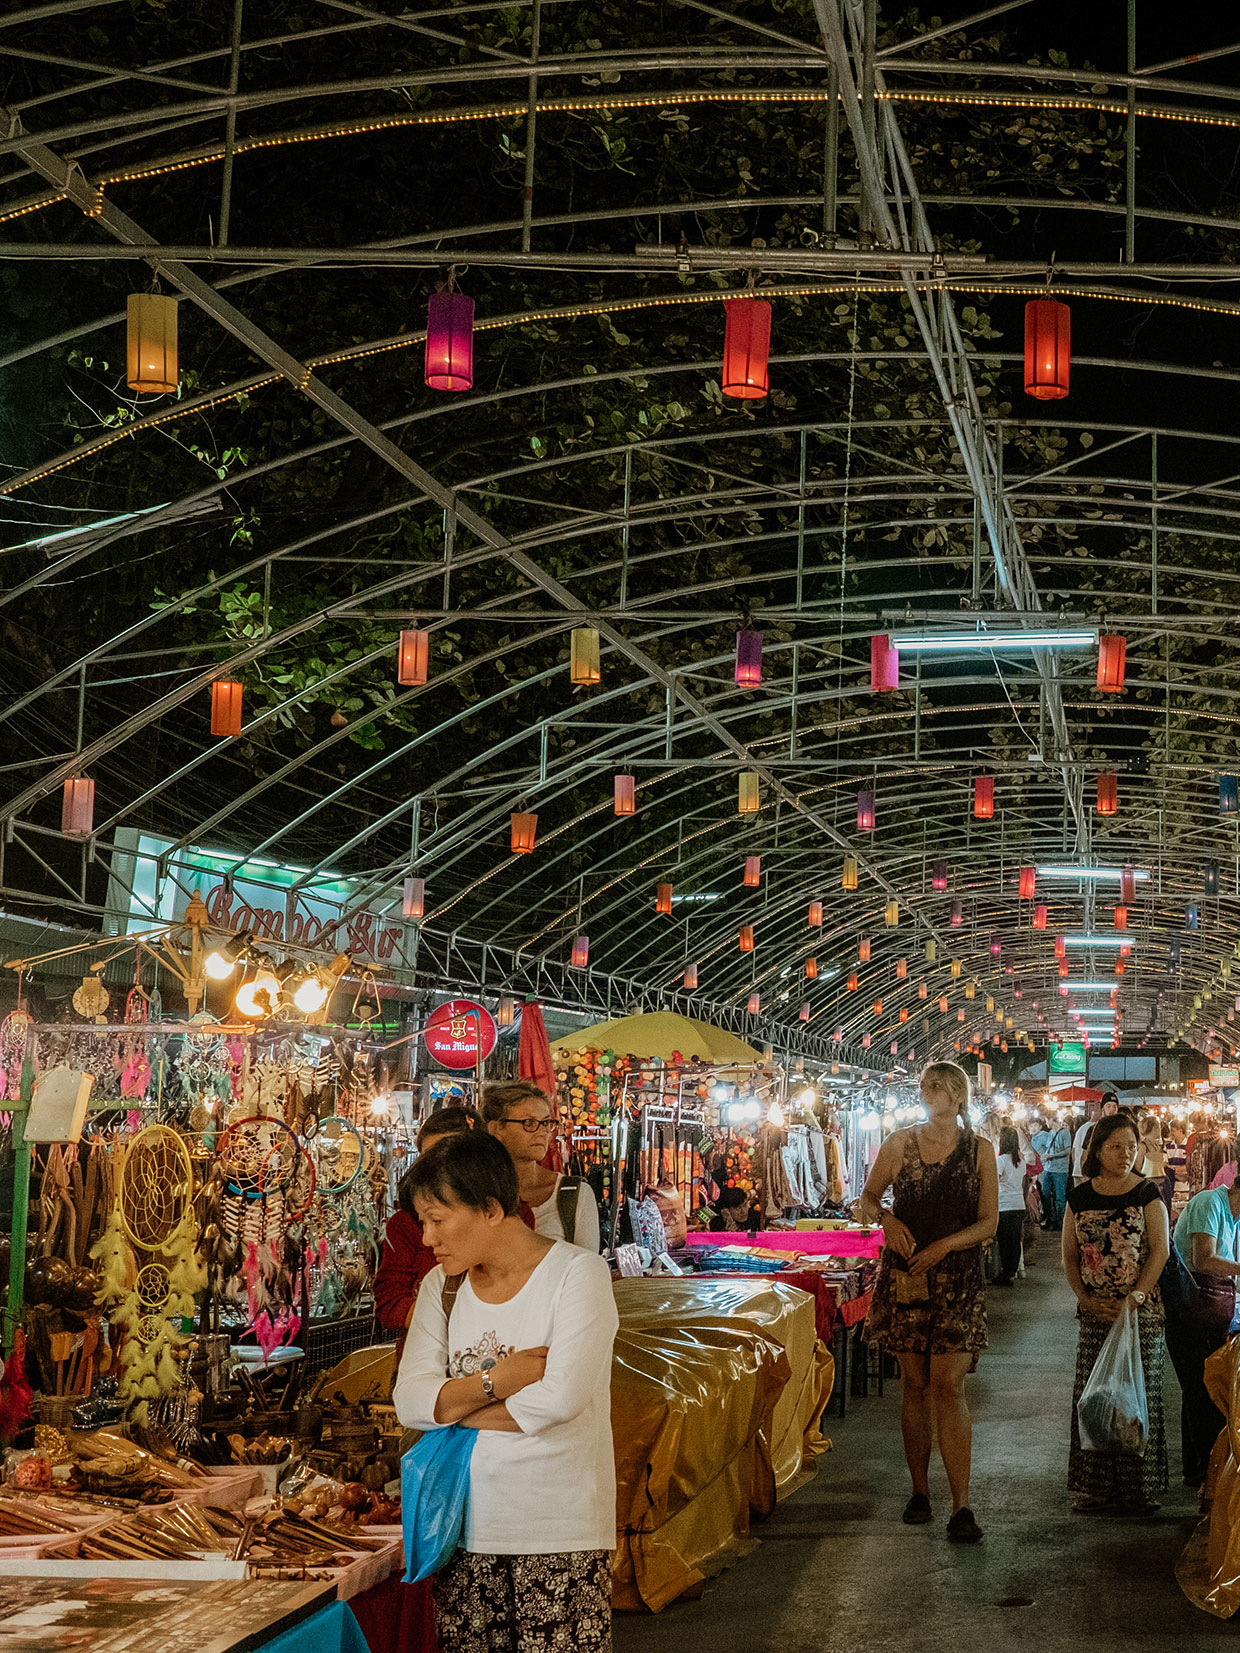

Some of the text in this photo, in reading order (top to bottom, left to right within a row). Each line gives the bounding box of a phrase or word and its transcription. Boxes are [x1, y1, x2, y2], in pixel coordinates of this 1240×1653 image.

[206, 884, 403, 959] Bamboo Bar
[434, 1041, 451, 1051] San
